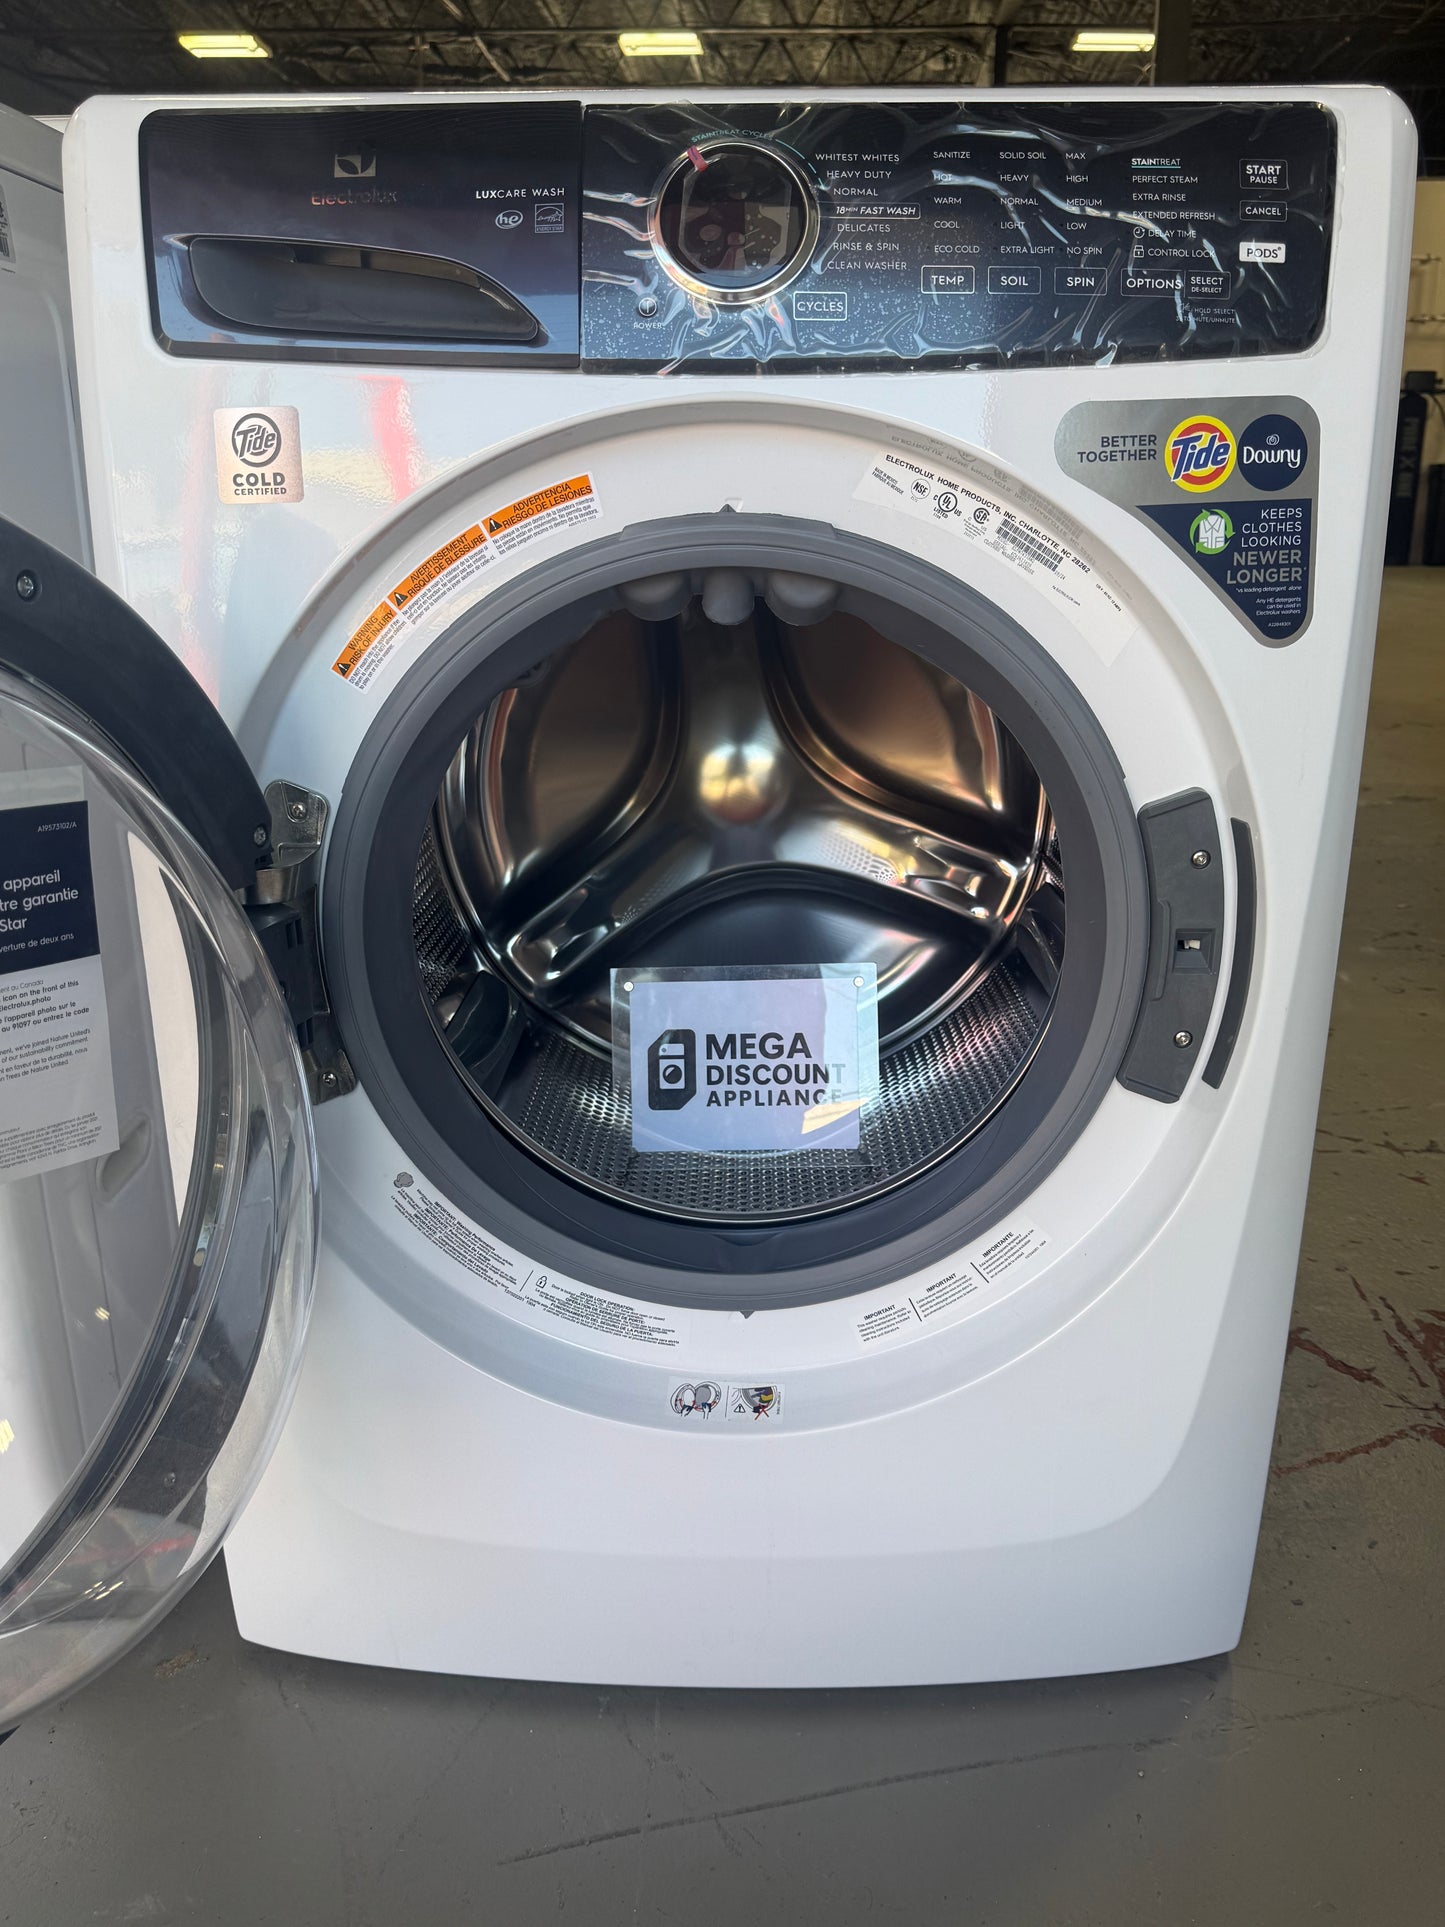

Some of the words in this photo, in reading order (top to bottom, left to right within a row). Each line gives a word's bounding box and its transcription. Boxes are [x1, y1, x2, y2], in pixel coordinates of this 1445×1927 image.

[815, 153, 859, 161] WHITEST
[861, 153, 900, 162] WHITES
[933, 151, 971, 159] SANITIZE
[999, 151, 1026, 160] SOLID
[1027, 151, 1047, 160] SOIL
[1065, 152, 1086, 160] MAX
[1131, 158, 1181, 166] STAINTREAT
[826, 170, 861, 179] HEAVY
[864, 170, 892, 179] DUTY
[1246, 165, 1282, 175] START
[933, 173, 953, 181] HOT
[1000, 174, 1029, 182] HEAVY
[1066, 175, 1089, 183] HIGH
[1132, 175, 1168, 184] PERFECT
[1169, 175, 1199, 184] STEAM
[1250, 175, 1278, 184] PAUSE
[475, 188, 527, 199] LUXCARE
[531, 187, 566, 198] WASH
[833, 187, 879, 196] NORMAL
[1132, 193, 1160, 201] EXTRA
[1161, 193, 1187, 201] RINSE
[933, 196, 962, 205] WARM
[1000, 197, 1039, 206] NORMAL
[1066, 198, 1103, 206] MEDIUM
[860, 206, 886, 215] FAST
[887, 206, 917, 215] WASH
[1132, 211, 1178, 220] EXTENDED
[1179, 211, 1216, 221] REFRESH
[1245, 206, 1282, 216] CANCEL
[837, 223, 891, 233] DELICATES
[933, 220, 961, 229] COOL
[1000, 221, 1026, 230] LIGHT
[1066, 222, 1087, 230] LOW
[1148, 229, 1176, 238] DELAY
[1177, 229, 1197, 239] TIME
[833, 242, 862, 251] RINSE
[865, 242, 873, 251] &
[876, 242, 900, 251] SPIN
[934, 244, 954, 254] ECO
[954, 244, 980, 254] COLD
[1000, 245, 1029, 255] EXTRA
[1030, 245, 1055, 255] LIGHT
[1066, 246, 1082, 255] NO
[1083, 246, 1103, 255] SPIN
[1148, 248, 1190, 258] CONTROL
[1191, 249, 1215, 259] LOCK
[827, 260, 861, 270] CLEAN
[864, 261, 908, 271] WASHER
[931, 275, 966, 286] TEMP
[1000, 275, 1029, 287] SOIL
[1066, 276, 1096, 288] SPIN
[1126, 278, 1184, 290] OPTIONS
[1190, 276, 1224, 286] SELECT
[1191, 286, 1223, 294] DE-SELECT
[796, 301, 844, 312] CYCLES
[633, 322, 662, 330] POWER
[236, 426, 276, 458] Tide
[1100, 434, 1158, 449] BETTER
[1077, 449, 1158, 464] TOGETHER
[1171, 432, 1232, 482] Tide
[1243, 445, 1301, 469] Downy
[232, 472, 286, 487] COLD
[234, 487, 287, 496] CERTIFIED
[513, 483, 572, 514] ADVERTENCIA
[502, 507, 535, 529] RIESGO
[535, 504, 549, 513] DE
[549, 485, 593, 507] LESIONES
[933, 506, 949, 519] LISTED
[885, 454, 936, 481] ELECTROLUX
[936, 476, 960, 492] HOME
[960, 487, 1002, 515] PRODUCTS,
[1003, 510, 1018, 524] INC.
[1018, 519, 1061, 552] CHARLOTTE,
[1060, 547, 1073, 560] NC
[1071, 556, 1092, 575] 28262
[1261, 507, 1303, 520] KEEPS
[1242, 521, 1302, 534] CLOTHES
[1241, 535, 1302, 548] LOOKING
[410, 533, 467, 583] AVERTISSEMENT
[1233, 549, 1302, 567] NEWER
[407, 569, 436, 597] RISQUE
[433, 561, 447, 575] DE
[446, 534, 487, 567] BLESSURE
[1243, 586, 1262, 594] leading
[1262, 585, 1287, 593] detergent
[348, 615, 379, 651] WARNING
[349, 646, 366, 666] RISK
[362, 635, 373, 648] OF
[370, 610, 395, 637] INJURY
[37, 821, 78, 833] A19573102/A
[3, 869, 61, 893] appareil
[22, 888, 79, 912] garantie
[0, 918, 28, 932] Star
[27, 938, 39, 948] de
[40, 936, 59, 946] deux
[60, 932, 75, 942] ans
[19, 979, 44, 990] Canada
[2, 991, 18, 1002] icon
[29, 987, 41, 996] the
[42, 984, 58, 994] front
[59, 982, 66, 990] of
[67, 980, 79, 988] this
[37, 1005, 57, 1017] photo
[12, 1020, 31, 1030] 91097
[43, 1013, 65, 1022] entrez
[73, 1006, 90, 1016] code
[31, 1039, 50, 1049] joined
[50, 1033, 69, 1044] Nature
[705, 1032, 813, 1061] MEGA
[8, 1054, 19, 1062] our
[19, 1045, 55, 1059] sustainability
[54, 1036, 89, 1050] commitment
[32, 1058, 41, 1066] de
[21, 1069, 30, 1077] de
[30, 1064, 50, 1075] Nature
[706, 1063, 846, 1086] DISCOUNT
[706, 1088, 842, 1107] APPLIANCE
[982, 1231, 1015, 1258] IMPORTANTE
[925, 1272, 958, 1293] IMPORTANT
[863, 1304, 897, 1321] IMPORTANT
